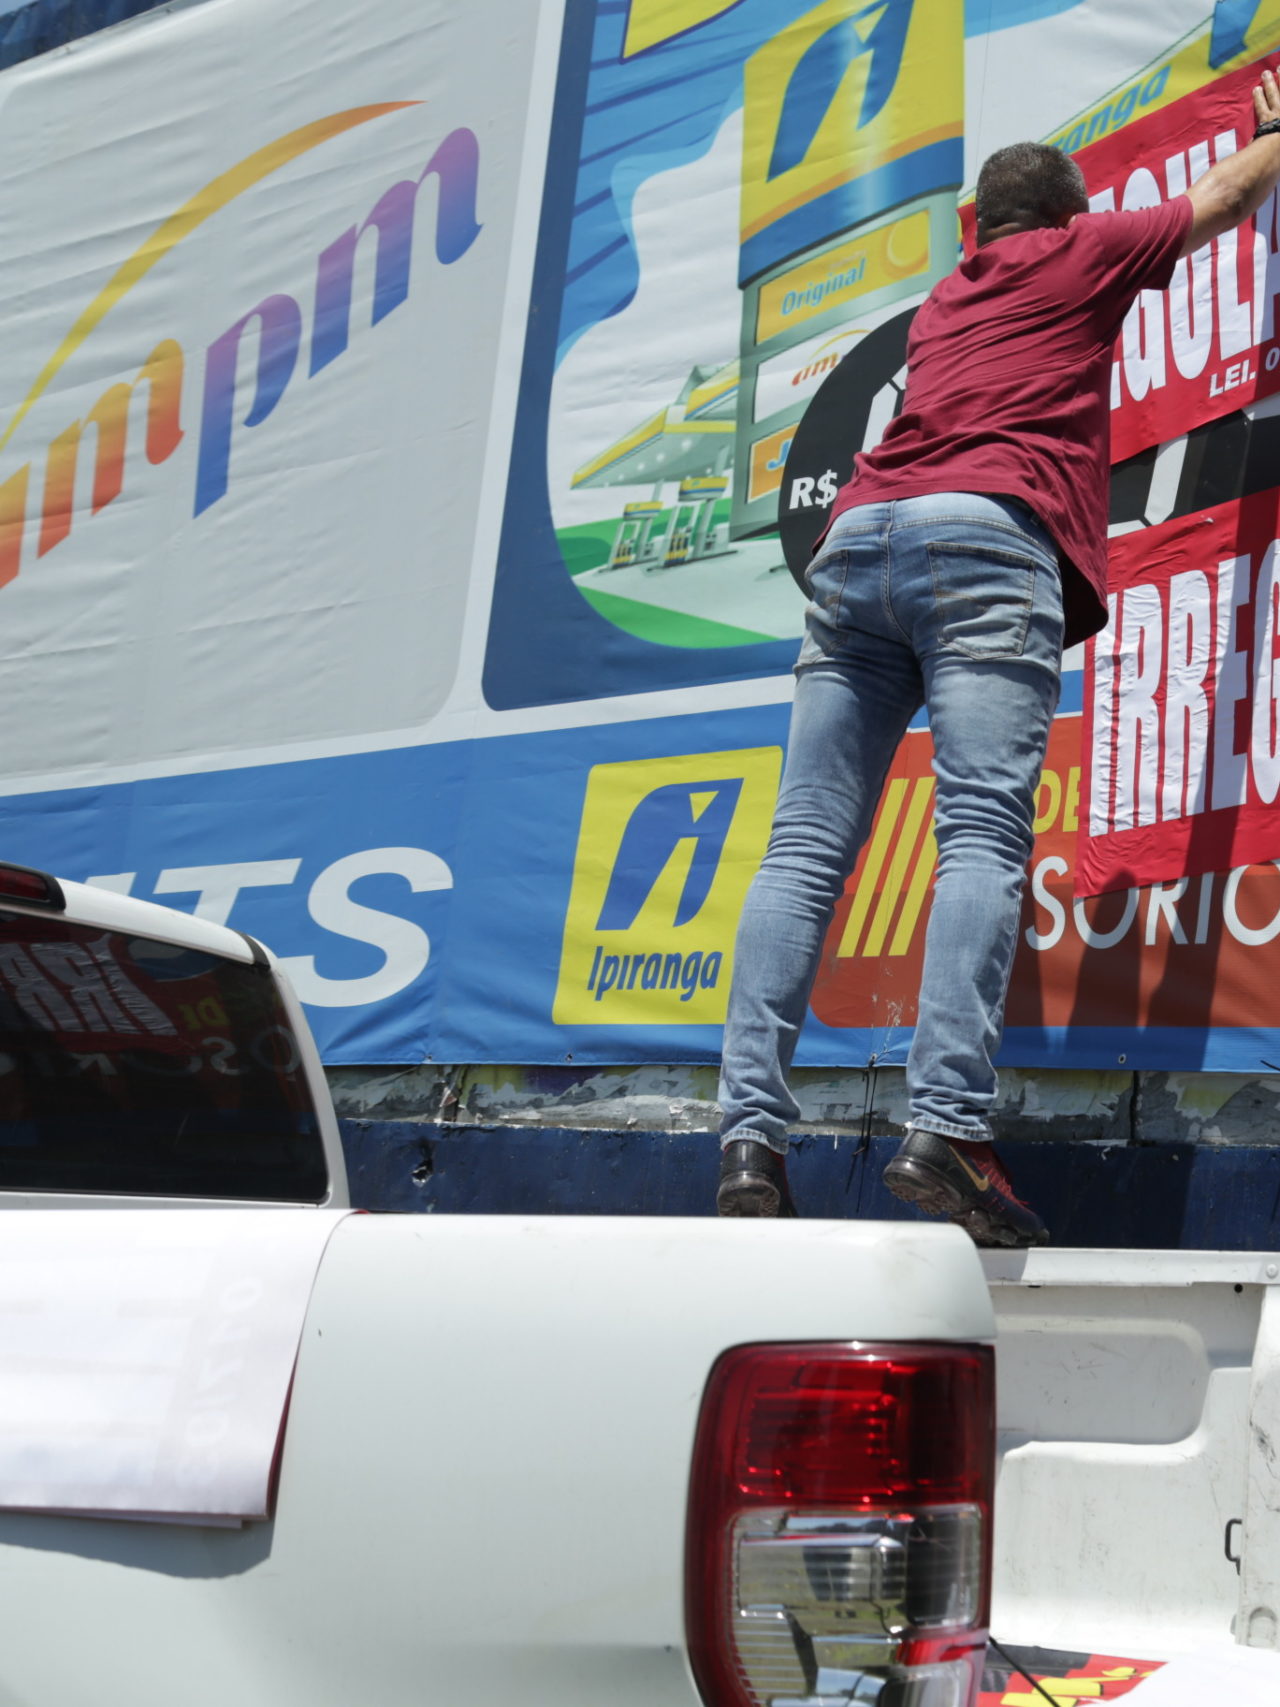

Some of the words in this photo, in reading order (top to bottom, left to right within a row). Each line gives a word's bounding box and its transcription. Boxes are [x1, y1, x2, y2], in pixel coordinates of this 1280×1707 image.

[780, 256, 866, 317] Original
[0, 127, 484, 591] mpm
[1209, 359, 1257, 399] LEI.
[789, 469, 838, 510] R$
[587, 945, 723, 1002] Ipiranga
